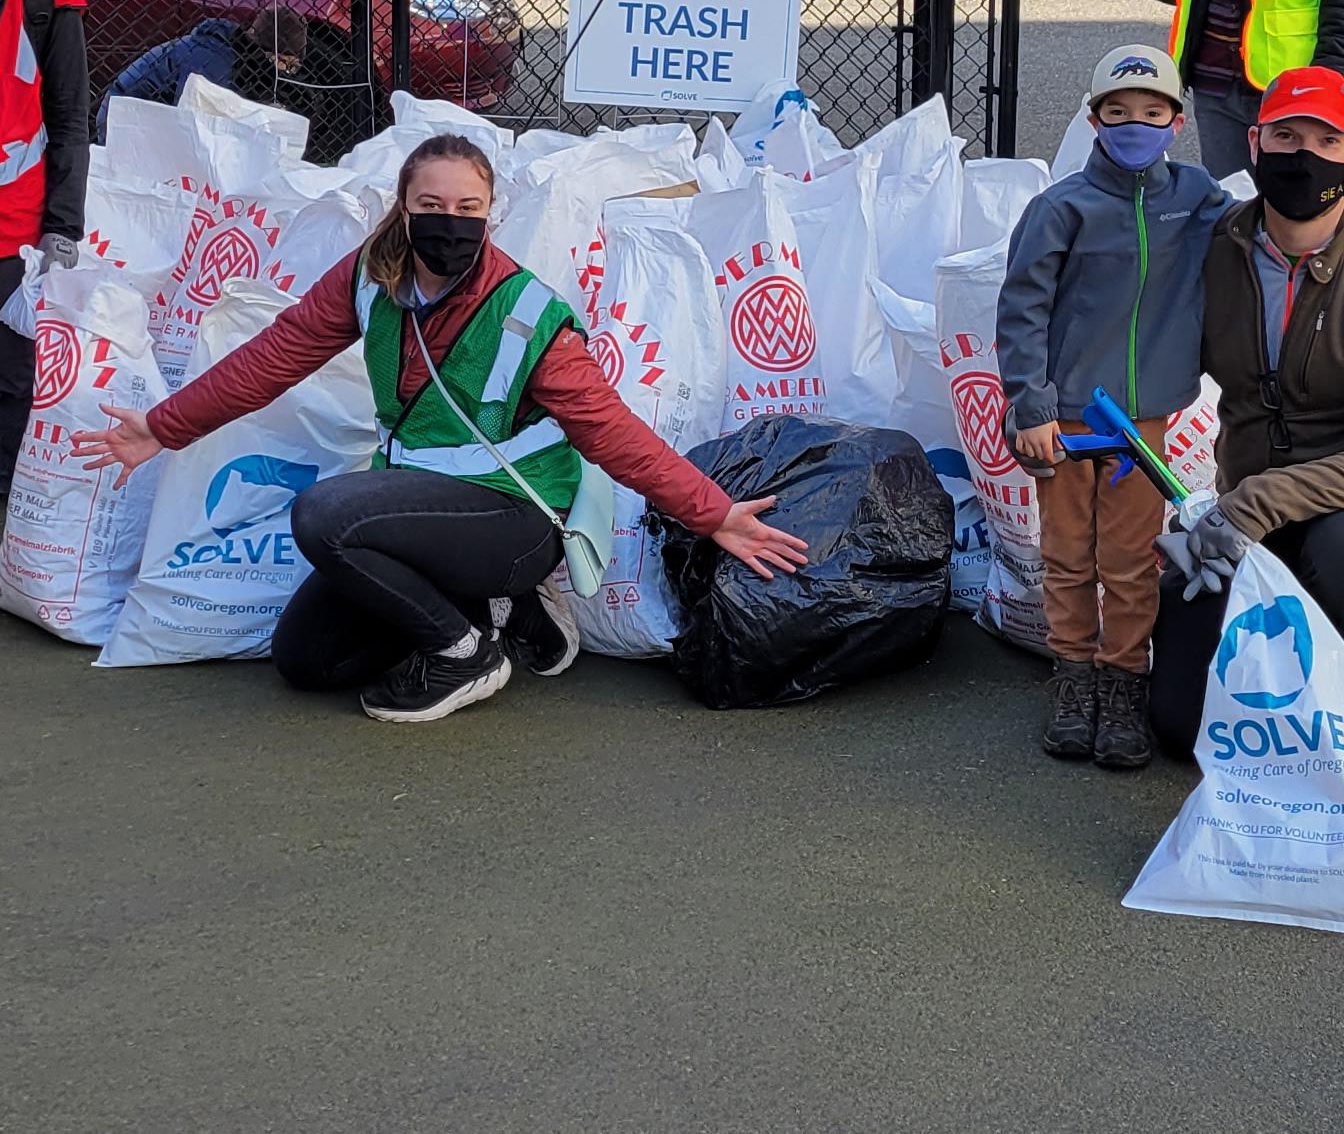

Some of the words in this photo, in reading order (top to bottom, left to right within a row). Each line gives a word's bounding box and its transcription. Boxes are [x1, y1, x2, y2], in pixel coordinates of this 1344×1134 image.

[618, 1, 750, 41] TRASH
[630, 46, 734, 83] HERE
[672, 91, 698, 101] SOLVE
[166, 532, 295, 570] SOLVE
[204, 569, 233, 580] Care
[235, 569, 250, 583] of
[250, 569, 294, 584] Oregon
[170, 595, 284, 618] solveoregon.org
[183, 625, 203, 635] YOU
[204, 627, 223, 635] FOR
[1212, 765, 1260, 781] king
[1263, 762, 1294, 777] Care
[1297, 758, 1311, 777] of
[1196, 816, 1238, 830] THANK
[1236, 824, 1259, 835] YOU
[1260, 825, 1283, 835] FOR
